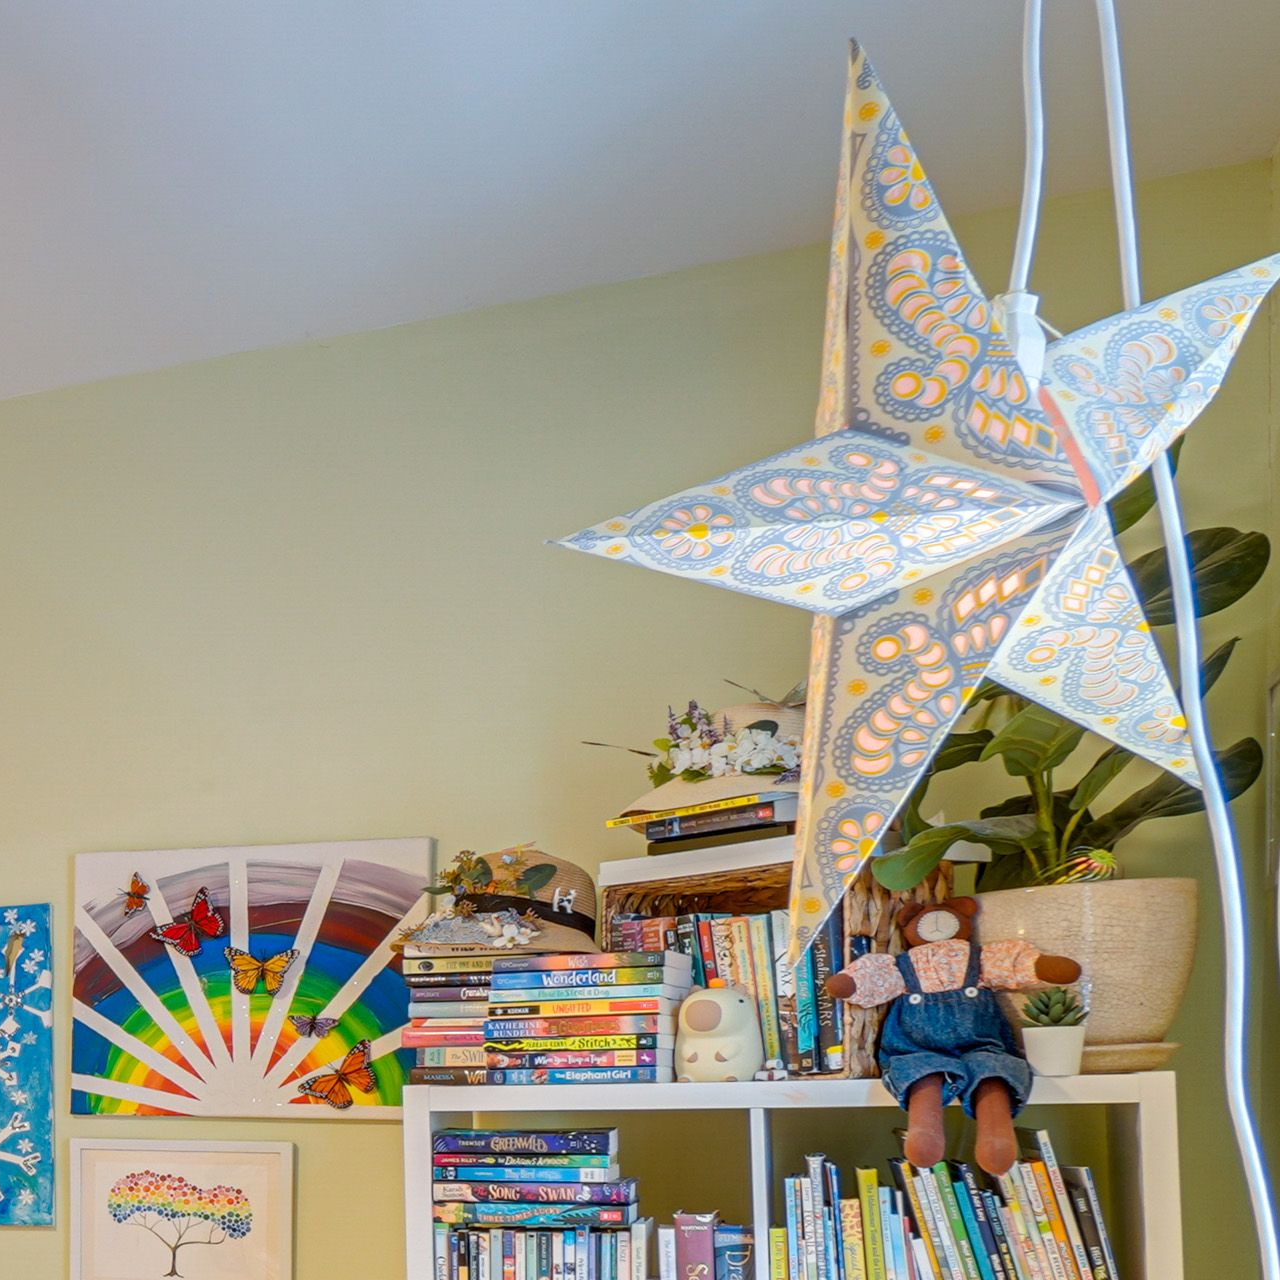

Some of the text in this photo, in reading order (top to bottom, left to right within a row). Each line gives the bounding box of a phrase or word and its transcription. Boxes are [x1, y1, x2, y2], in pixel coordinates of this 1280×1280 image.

[542, 970, 616, 985] Wonderland
[565, 1070, 611, 1081] Elephant
[612, 1070, 631, 1079] Girl
[488, 1185, 520, 1200] SONG
[539, 1186, 575, 1201] SWAN
